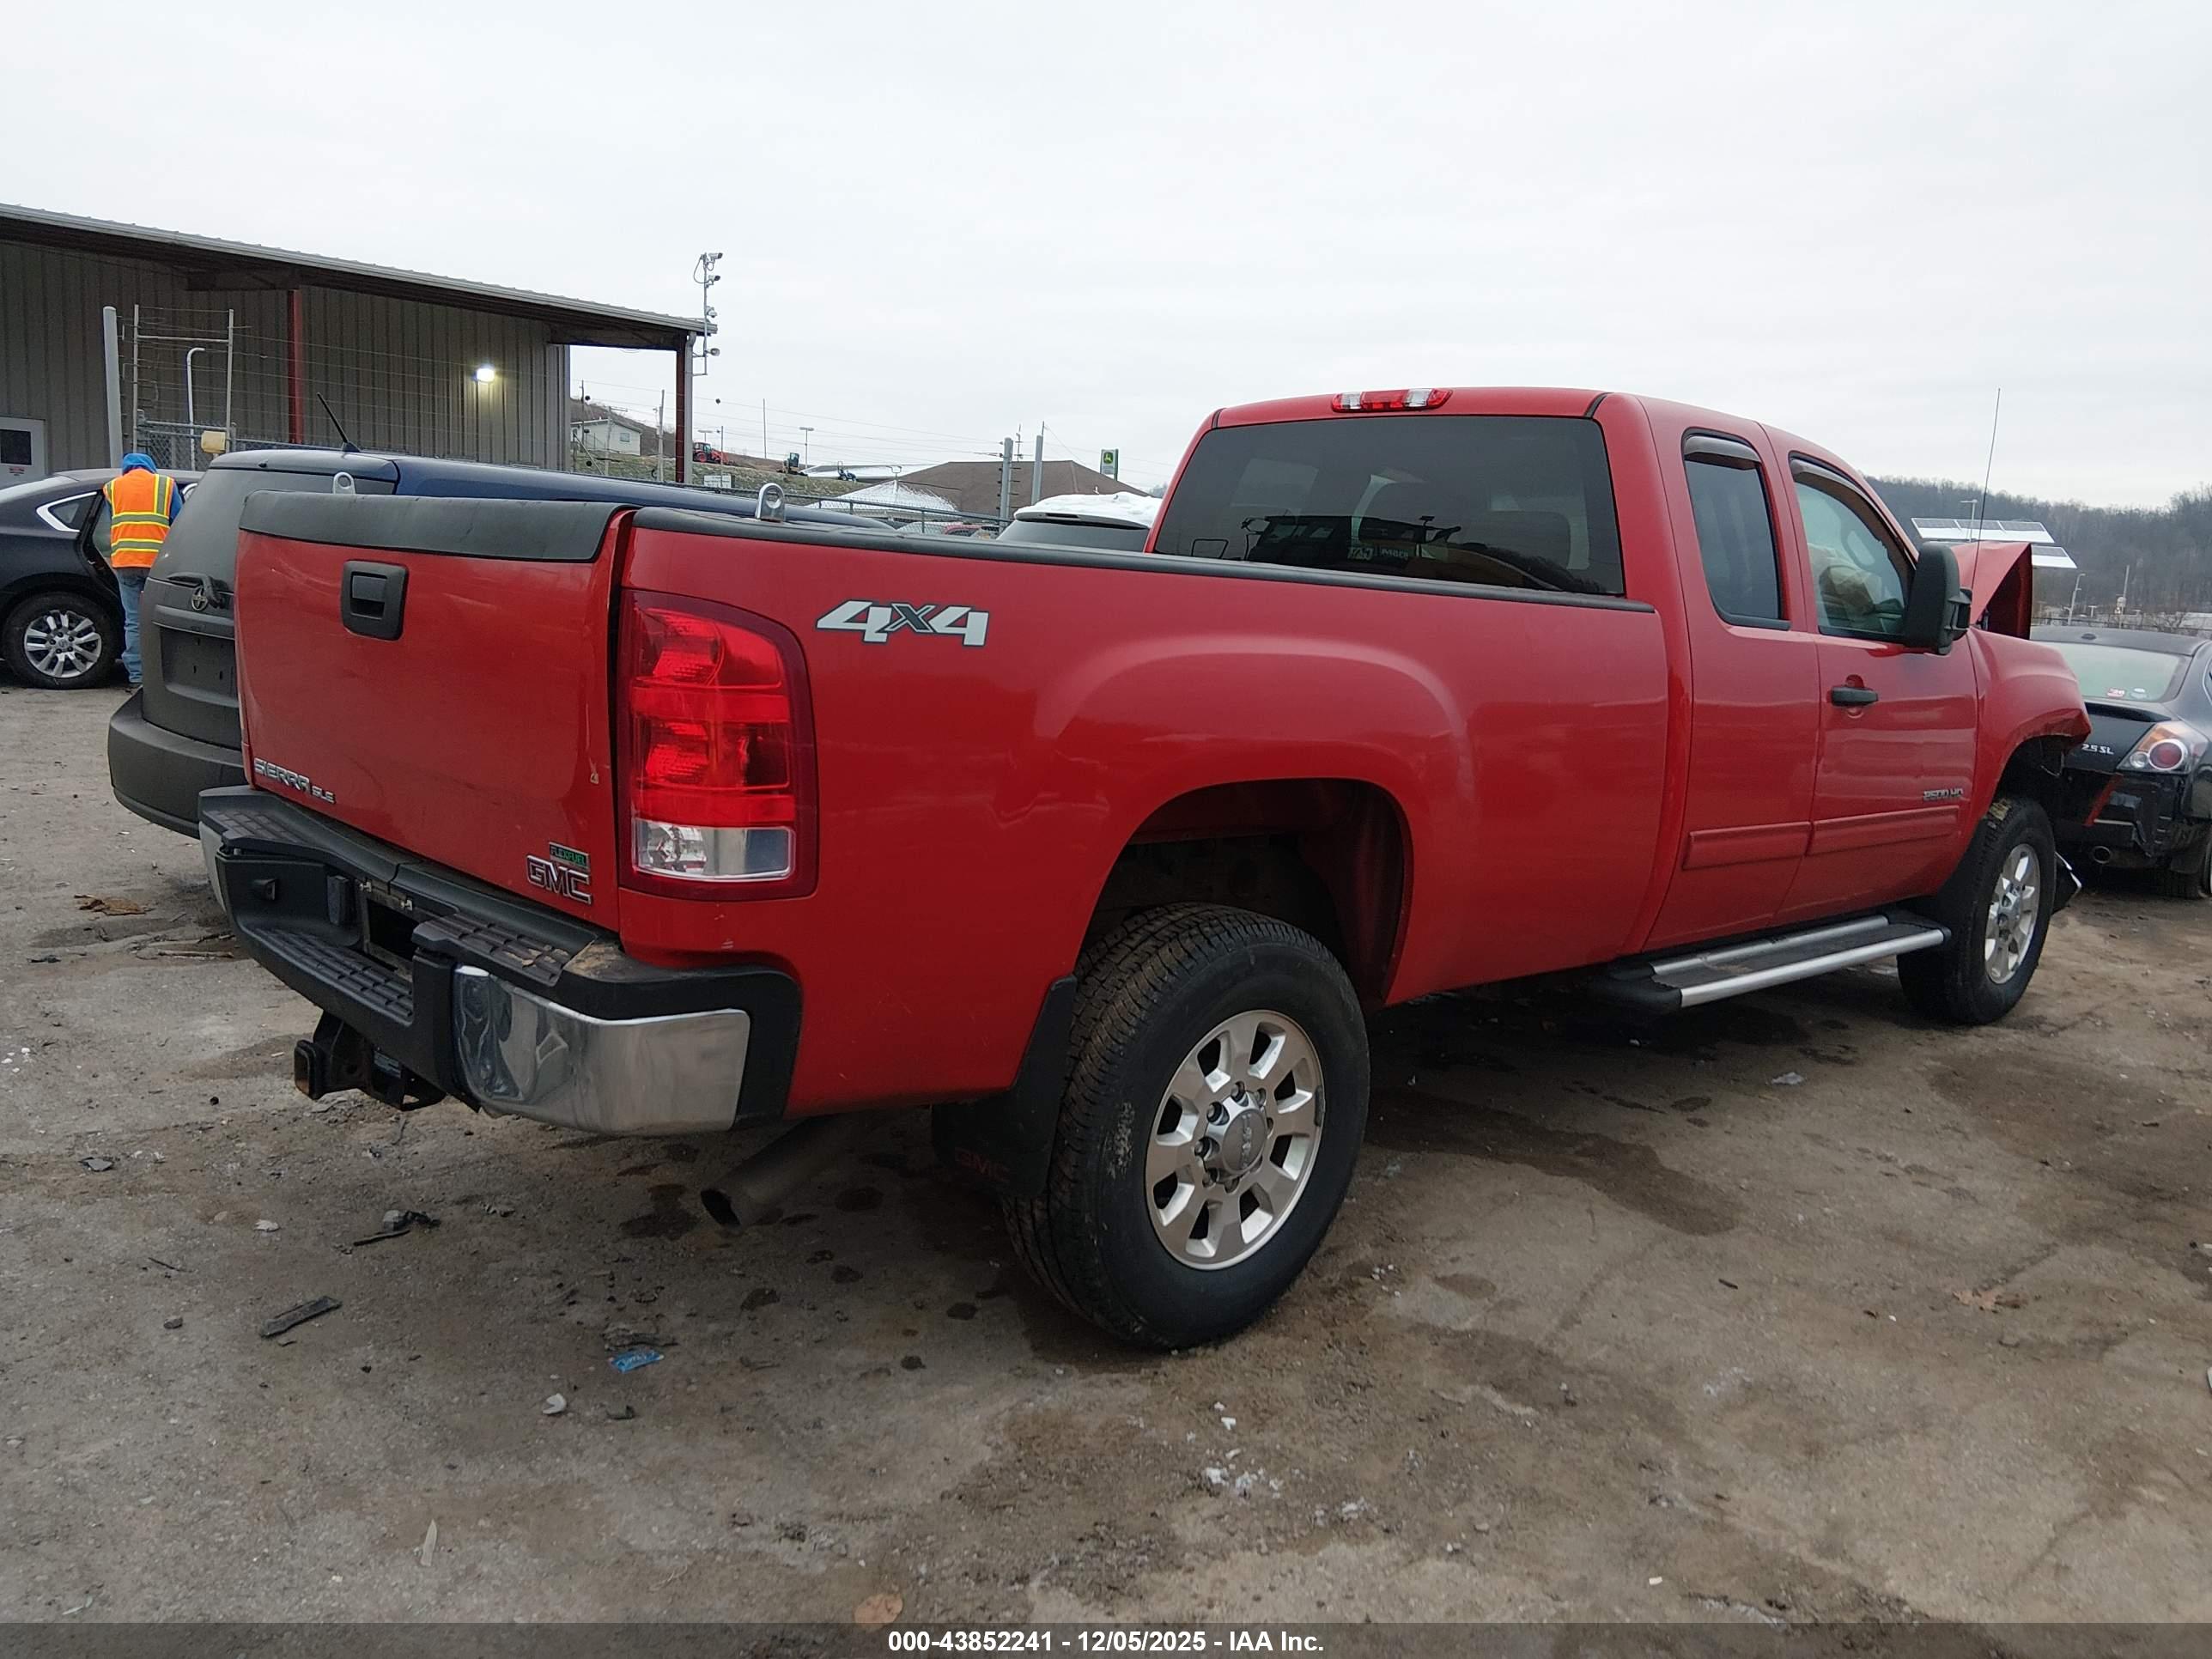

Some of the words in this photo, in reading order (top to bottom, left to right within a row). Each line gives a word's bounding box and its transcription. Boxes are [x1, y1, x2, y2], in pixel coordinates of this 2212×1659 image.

[254, 757, 311, 793] SIERRA
[311, 785, 336, 805] SLE
[526, 854, 592, 905] GMC
